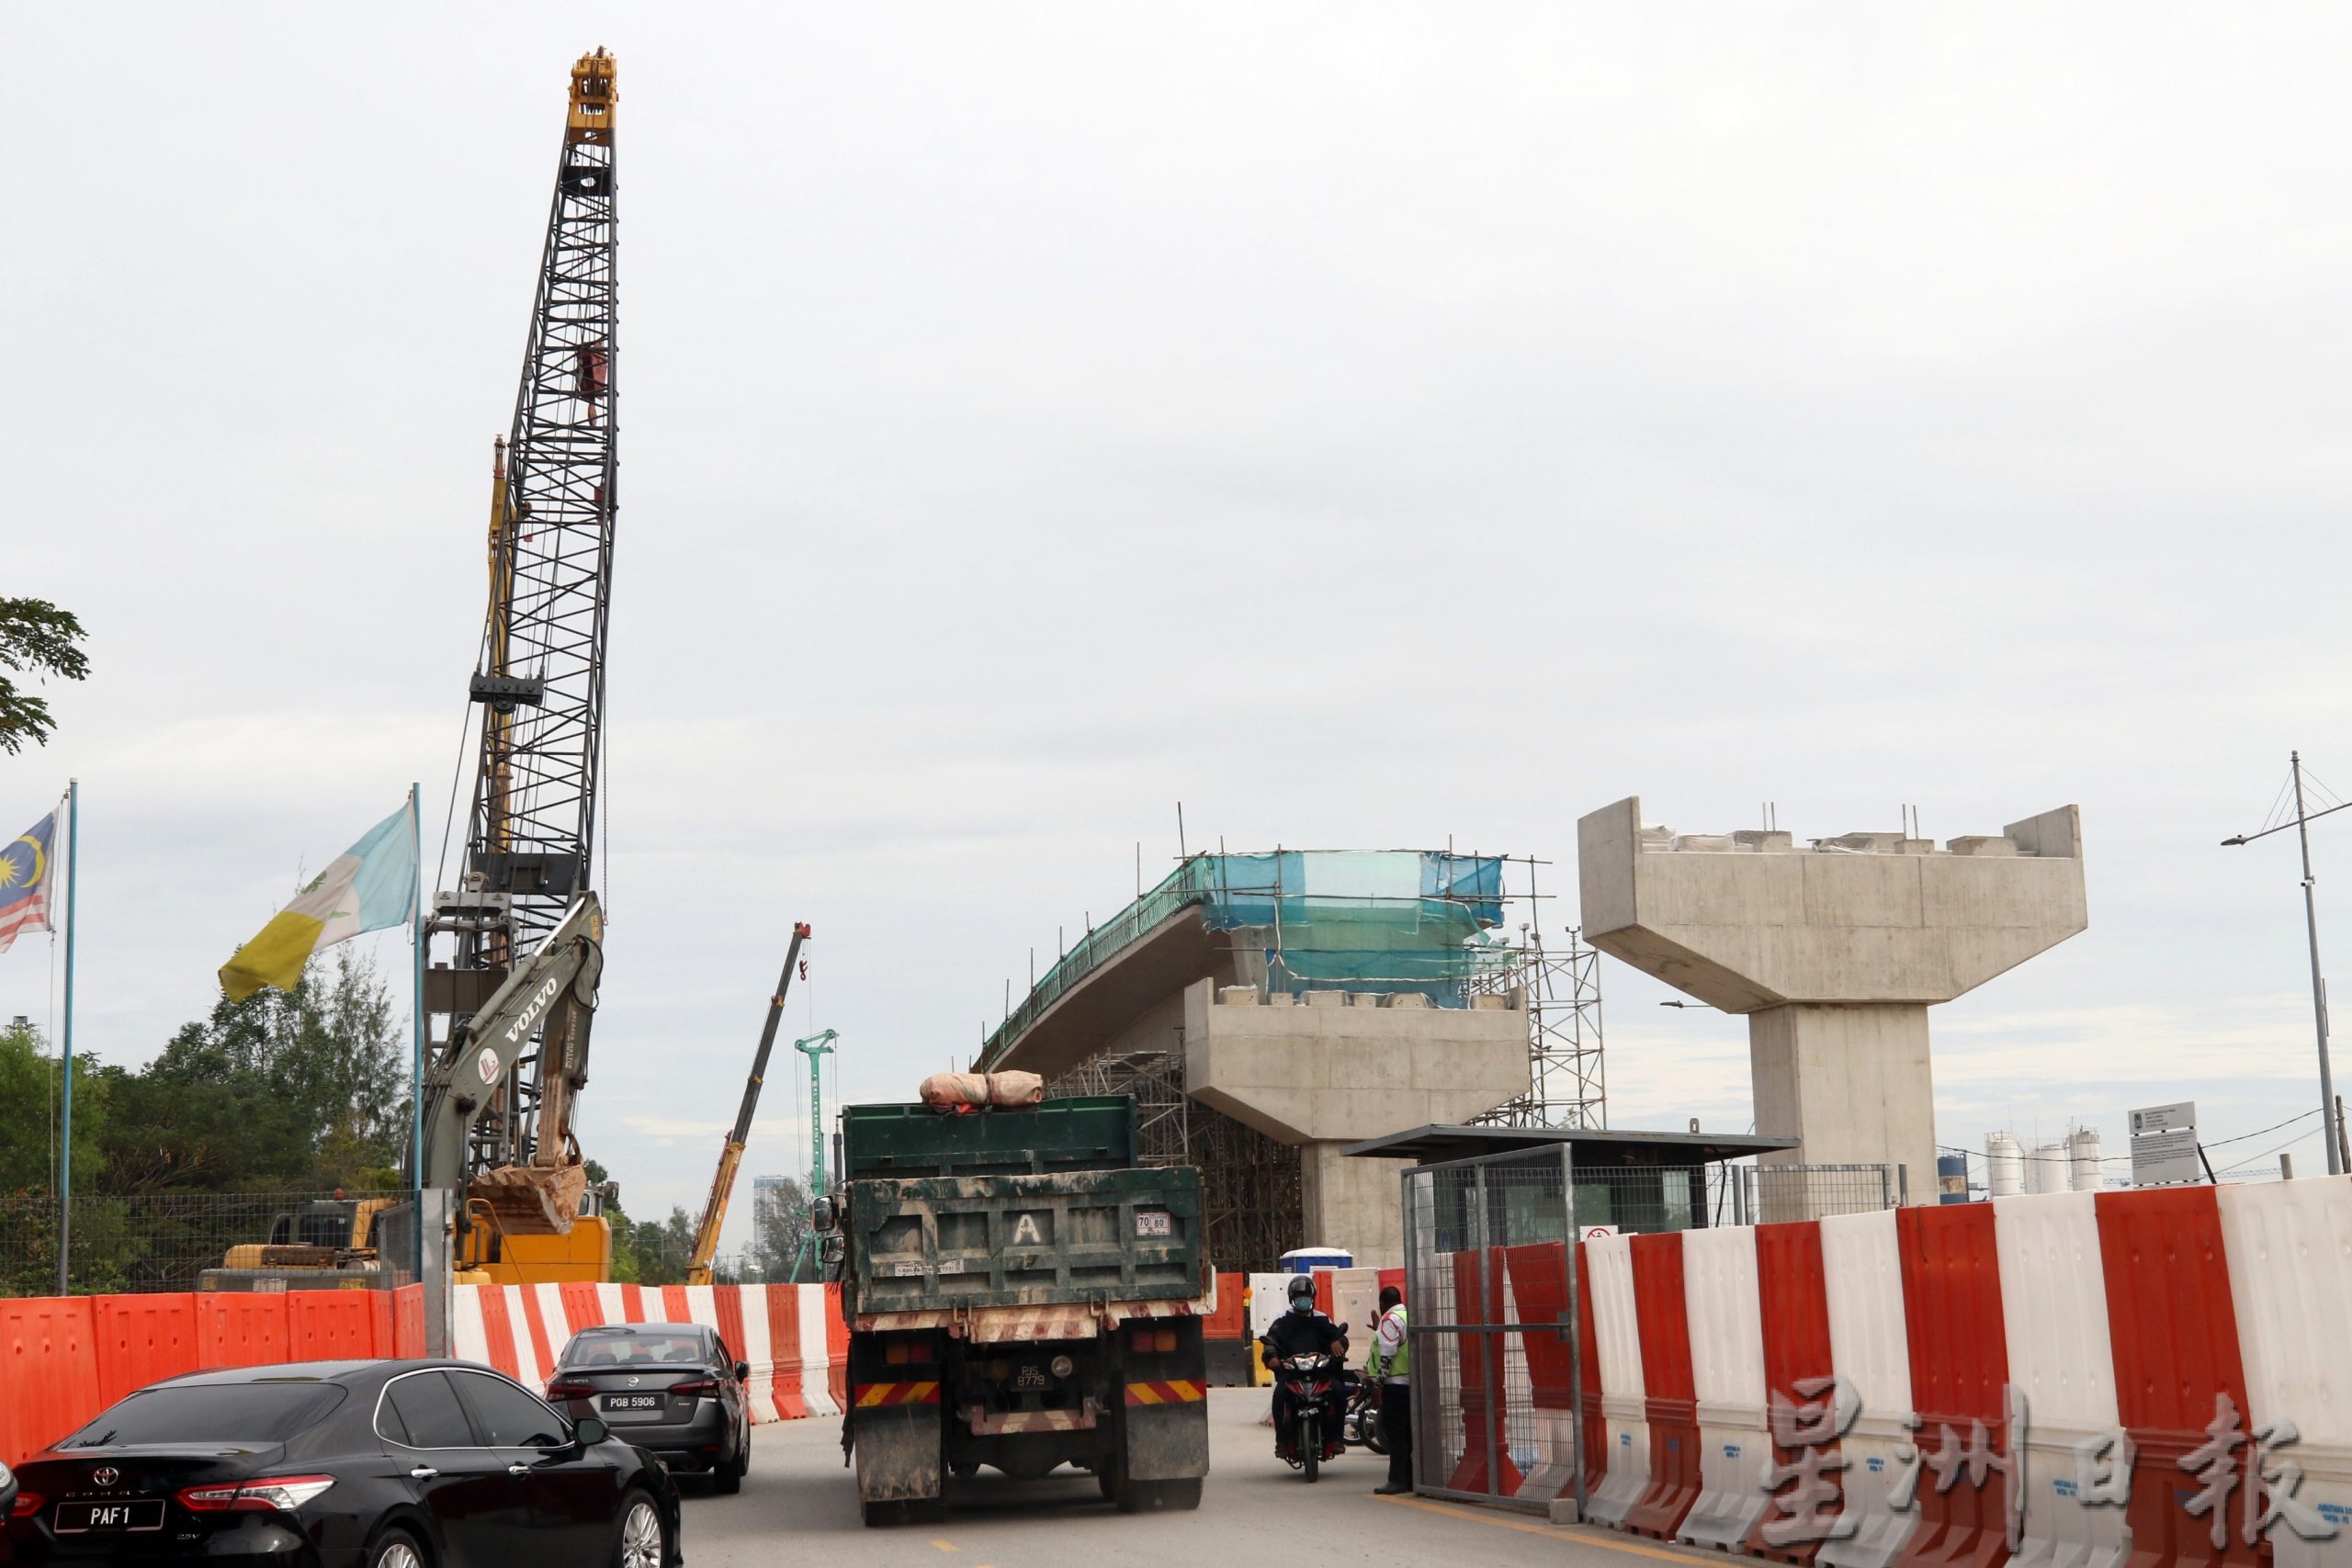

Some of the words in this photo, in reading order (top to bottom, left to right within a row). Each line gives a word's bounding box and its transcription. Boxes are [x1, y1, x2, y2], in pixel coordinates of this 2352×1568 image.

[505, 977, 557, 1043] VOLVO
[1139, 1217, 1149, 1227] 70
[1154, 1219, 1164, 1227] 80
[1014, 1213, 1040, 1244] A
[1022, 1366, 1039, 1376] PJS
[1017, 1375, 1045, 1386] 8779
[631, 1396, 655, 1406] 5906
